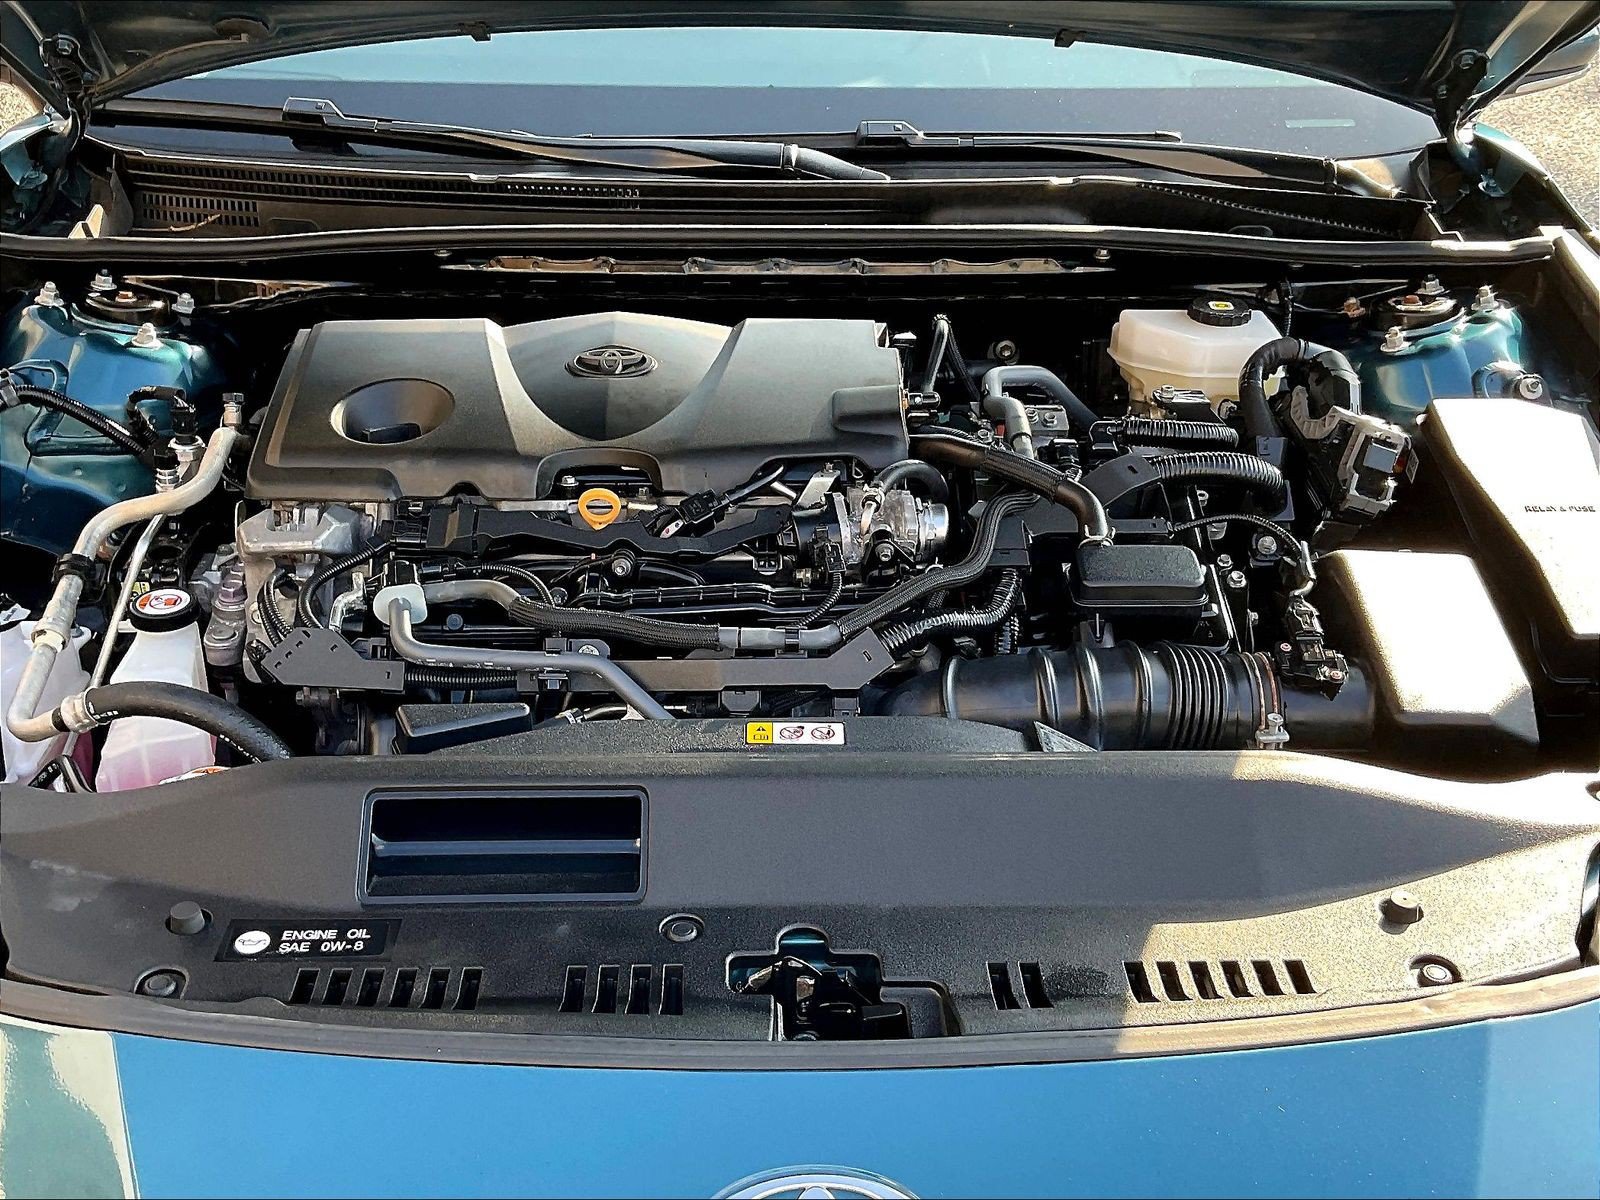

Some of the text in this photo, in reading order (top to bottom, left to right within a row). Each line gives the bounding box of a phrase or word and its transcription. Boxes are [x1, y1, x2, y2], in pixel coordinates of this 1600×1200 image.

[281, 928, 371, 940] ENGINE OIL
[279, 940, 364, 953] SAE 0W-8
